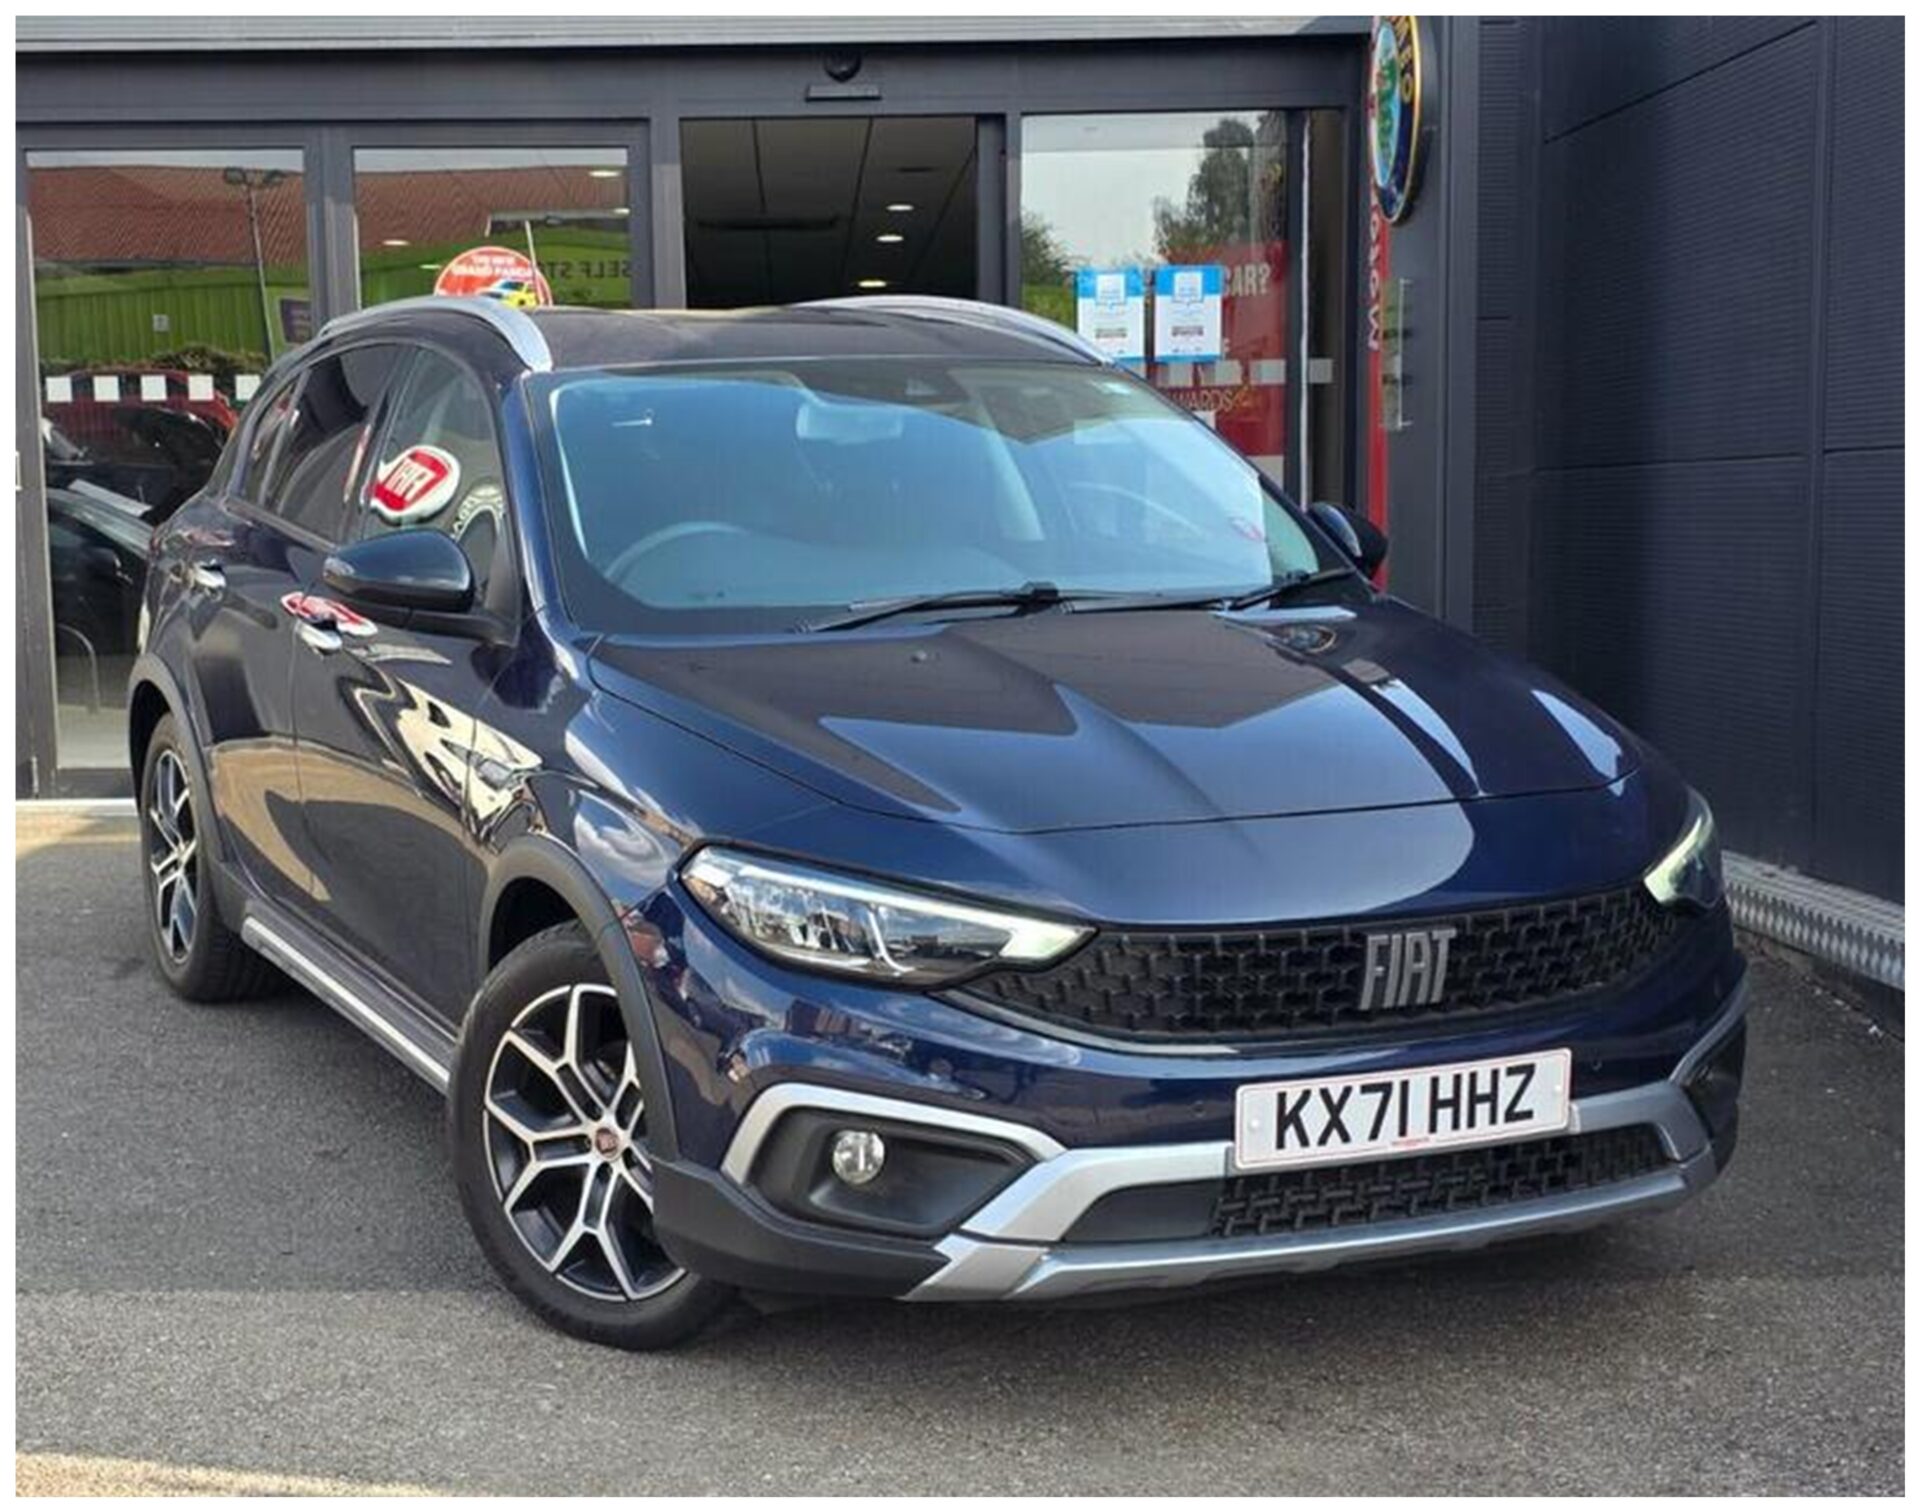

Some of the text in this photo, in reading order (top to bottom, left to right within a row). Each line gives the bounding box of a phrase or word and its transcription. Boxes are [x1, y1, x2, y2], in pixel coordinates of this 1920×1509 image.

[1359, 927, 1457, 1010] FIAT
[1276, 1063, 1536, 1150] KX71 HHZ
